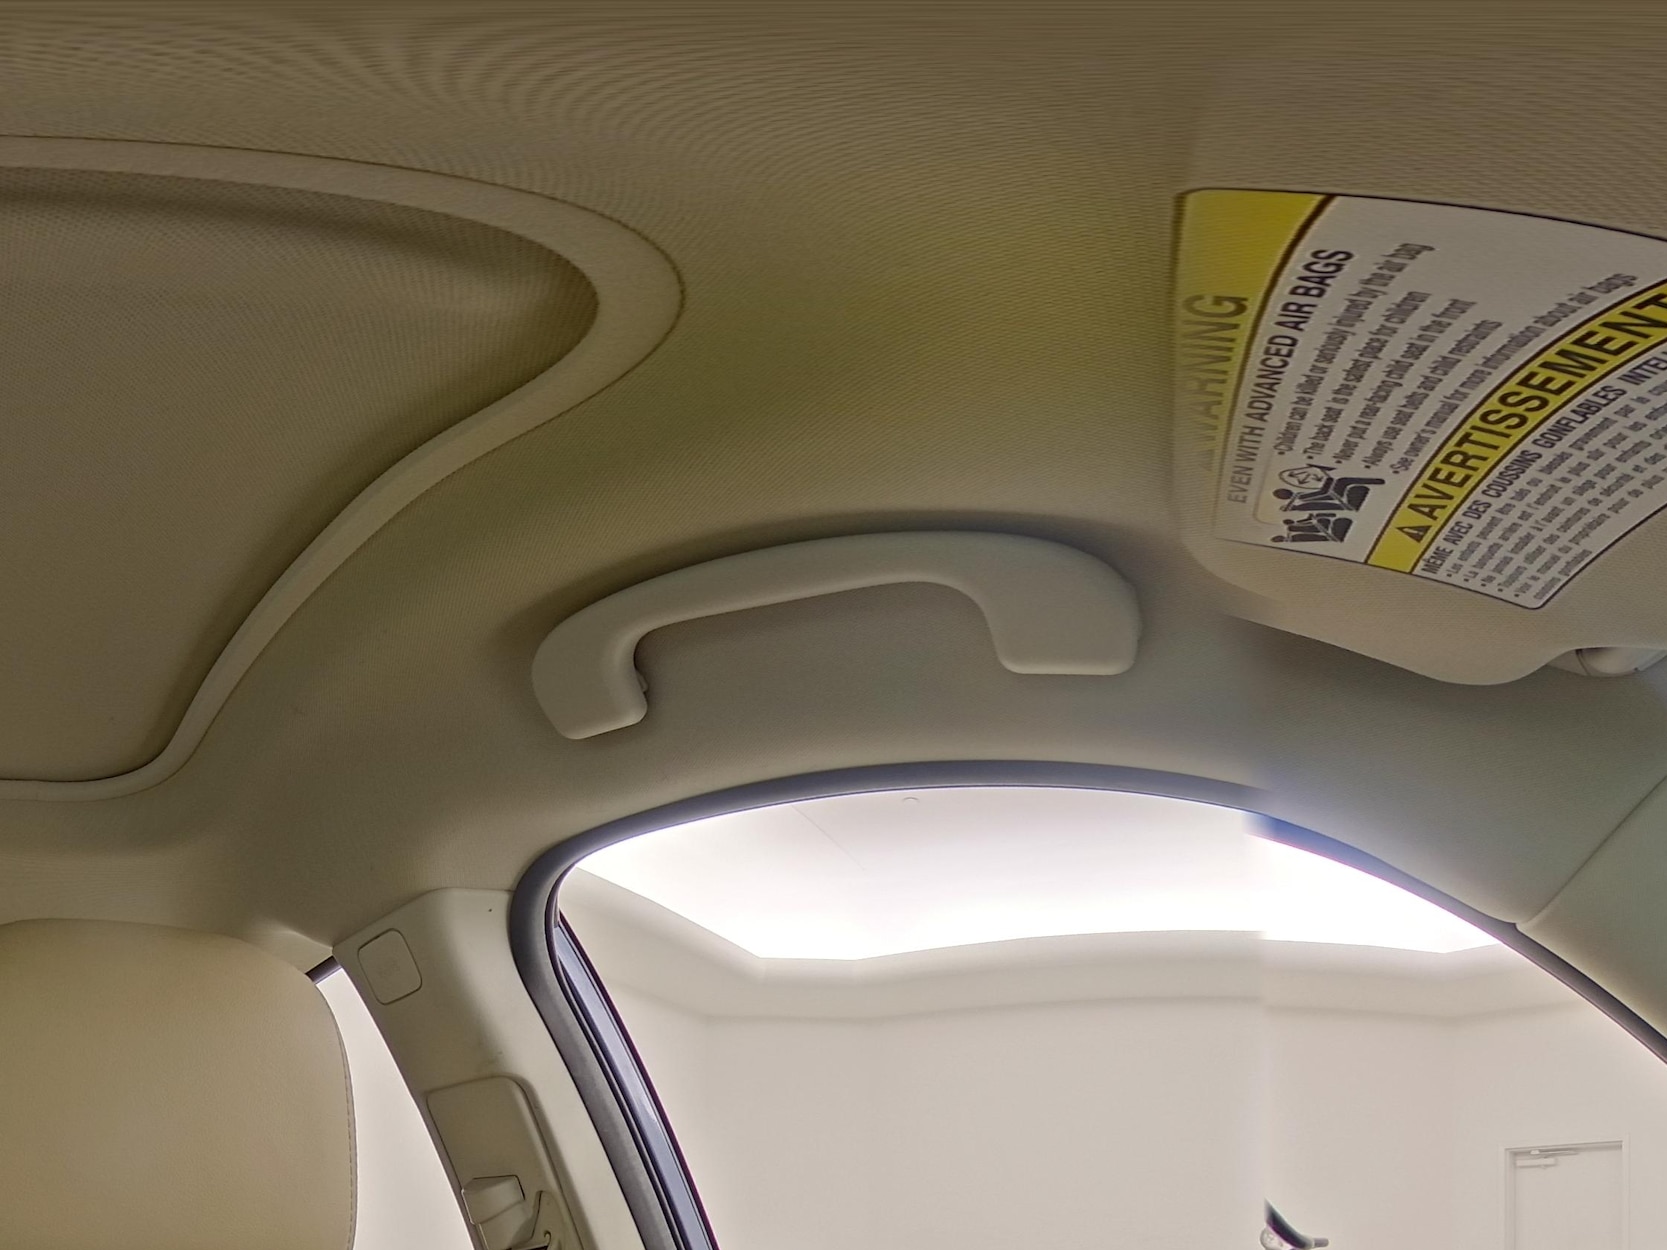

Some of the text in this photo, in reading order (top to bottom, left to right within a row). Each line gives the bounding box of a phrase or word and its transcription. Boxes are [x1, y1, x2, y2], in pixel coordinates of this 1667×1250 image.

[1226, 249, 1353, 503] EVEN WITH ADVANCED AIR BAGS
[1420, 545, 1453, 574] MÊME
[1442, 520, 1473, 545] AVEC
[1461, 499, 1492, 520] DES
[1481, 449, 1542, 498] COUSSINS
[1532, 385, 1626, 448] GONFLABLES
